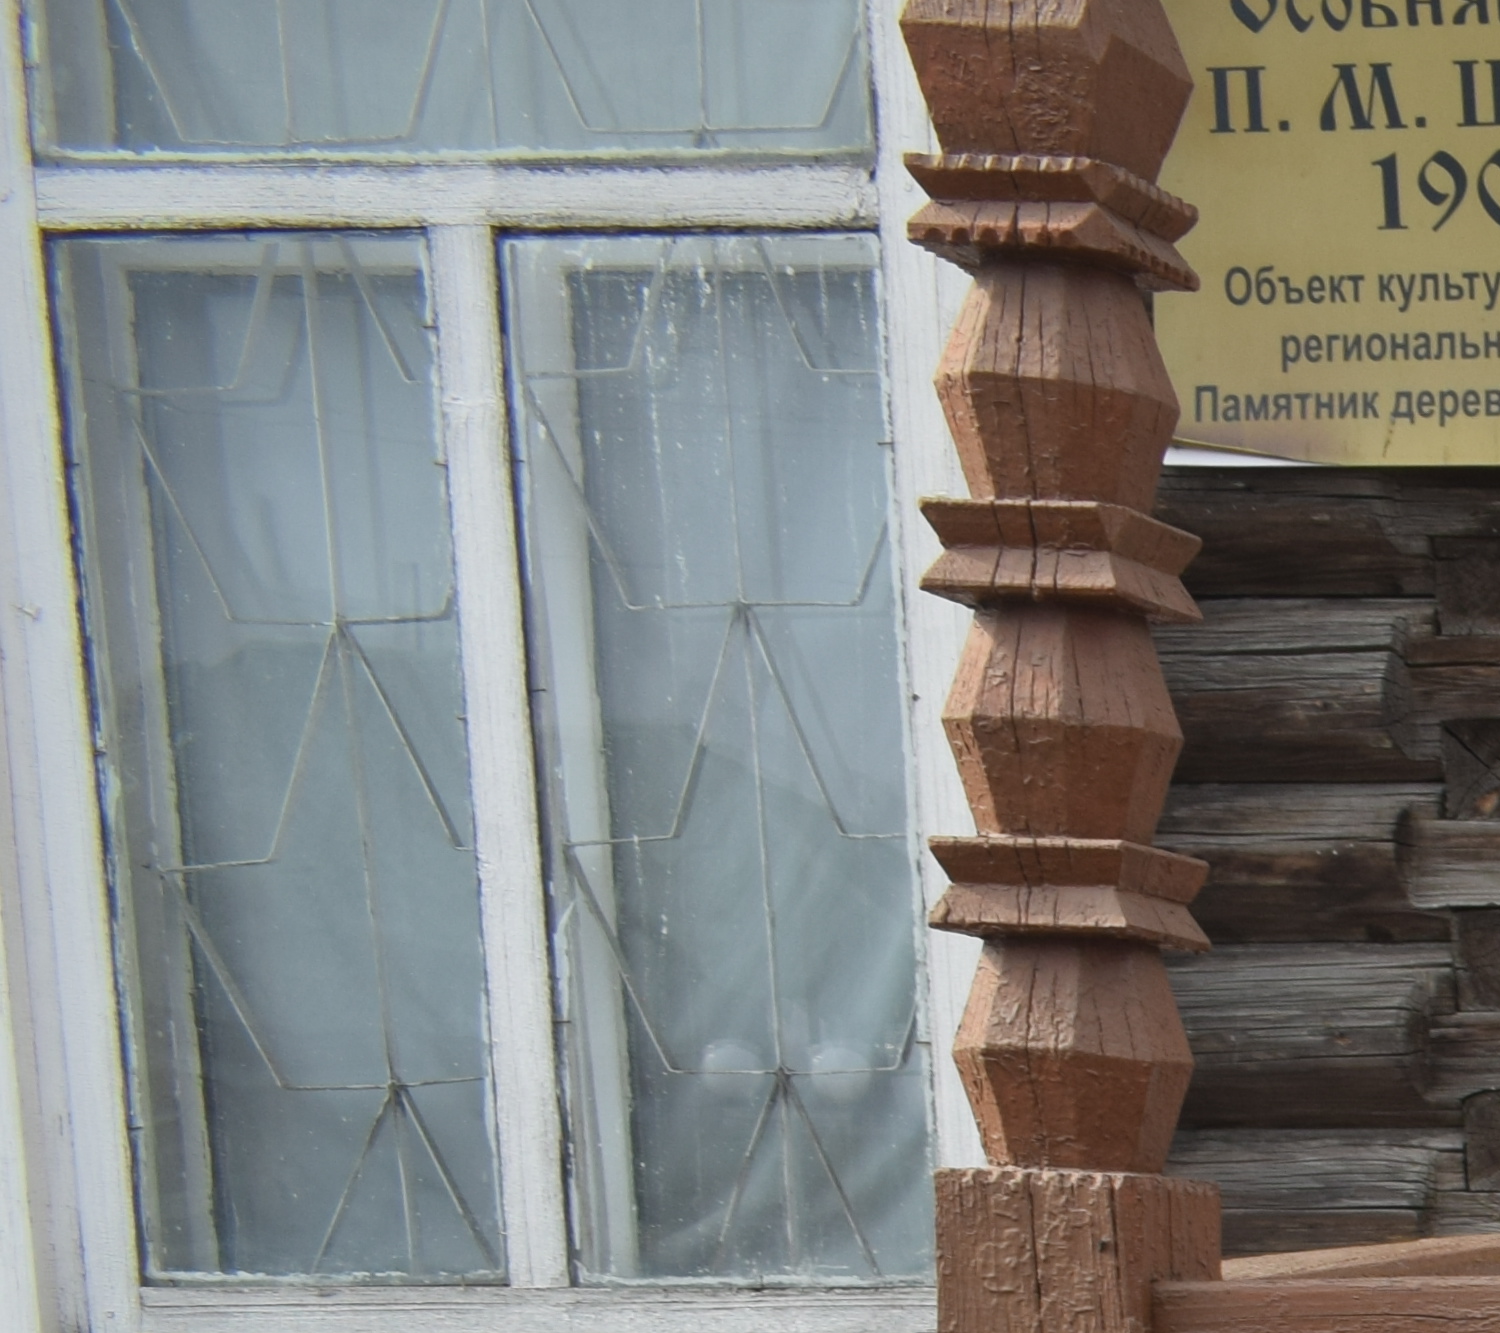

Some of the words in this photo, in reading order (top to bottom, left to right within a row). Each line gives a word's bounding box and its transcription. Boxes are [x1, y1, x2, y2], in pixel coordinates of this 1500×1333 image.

[1206, 66, 1290, 133] П.
[1320, 62, 1426, 131] М.
[1224, 266, 1365, 306] Объект
[1194, 385, 1380, 423] Памятник
